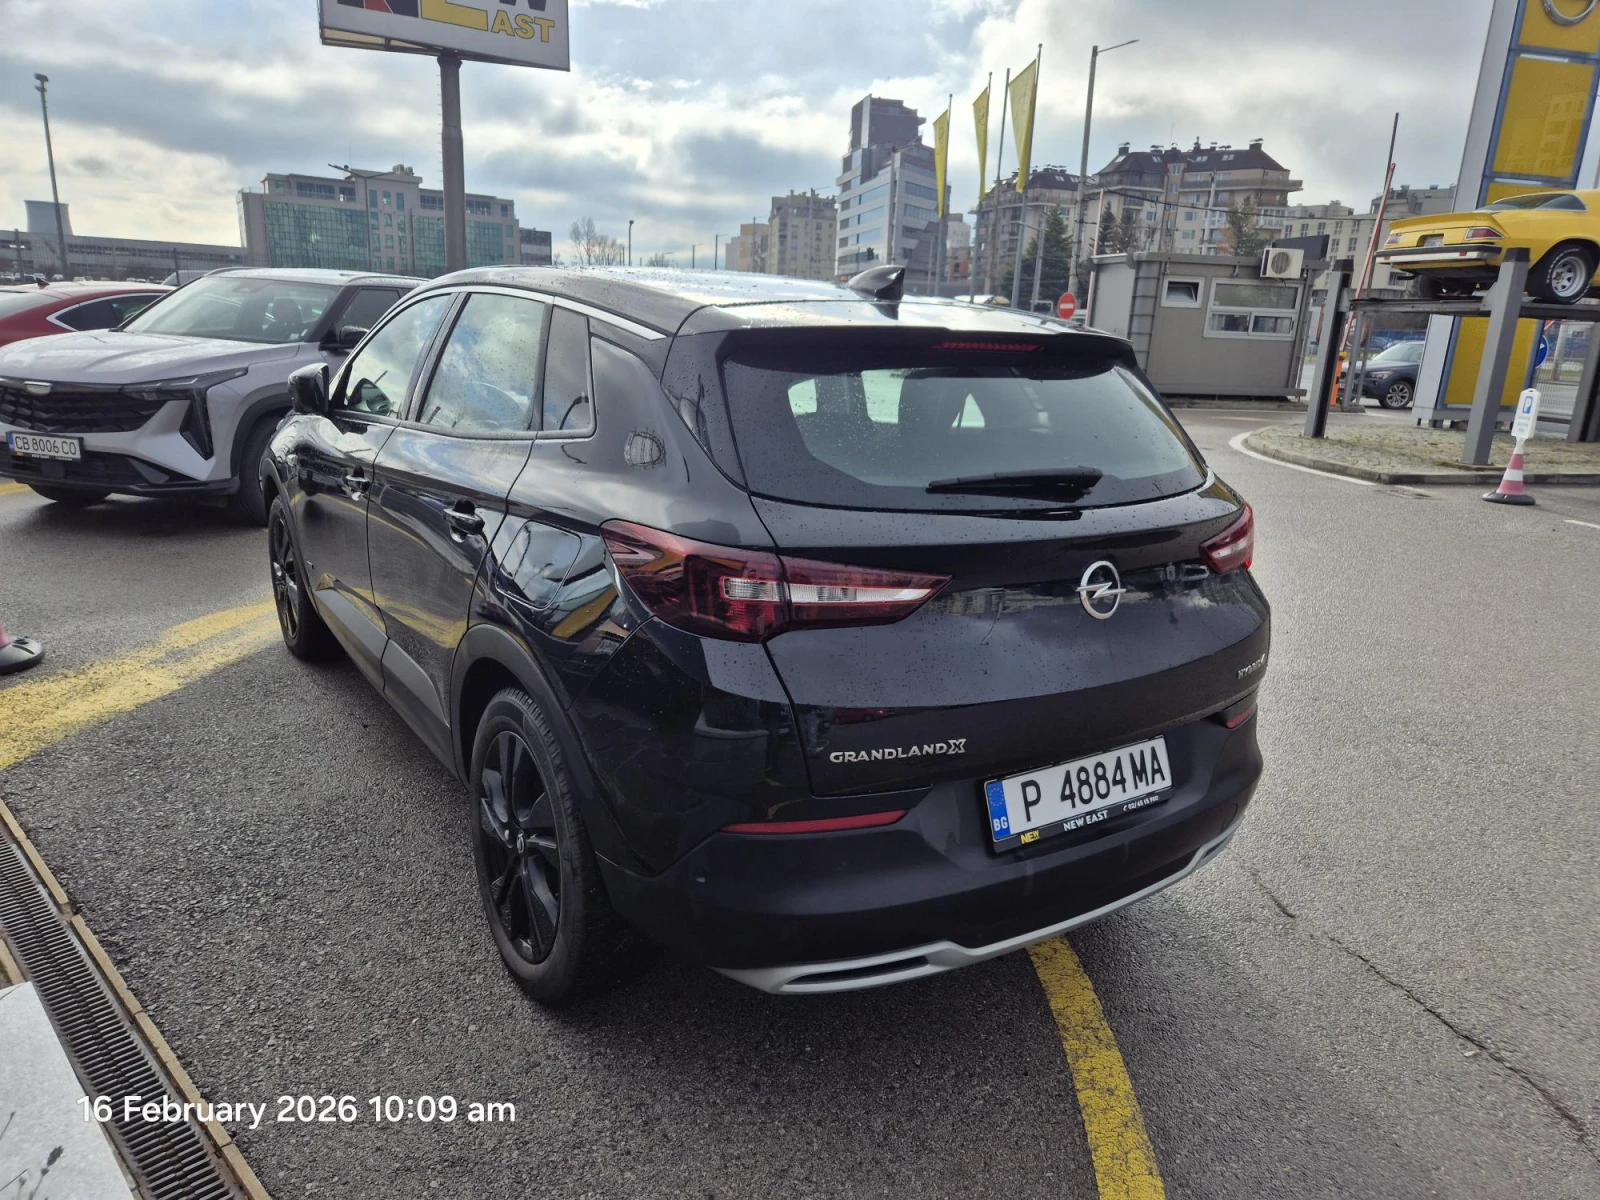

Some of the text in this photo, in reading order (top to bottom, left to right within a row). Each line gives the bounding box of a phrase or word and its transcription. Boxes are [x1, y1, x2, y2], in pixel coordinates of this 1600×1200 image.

[15, 436, 77, 455] CB 8006 CO
[1020, 779, 1042, 822] P
[993, 816, 1009, 832] BG
[1063, 810, 1109, 832] NEW EAST
[1020, 830, 1041, 844] NEW
